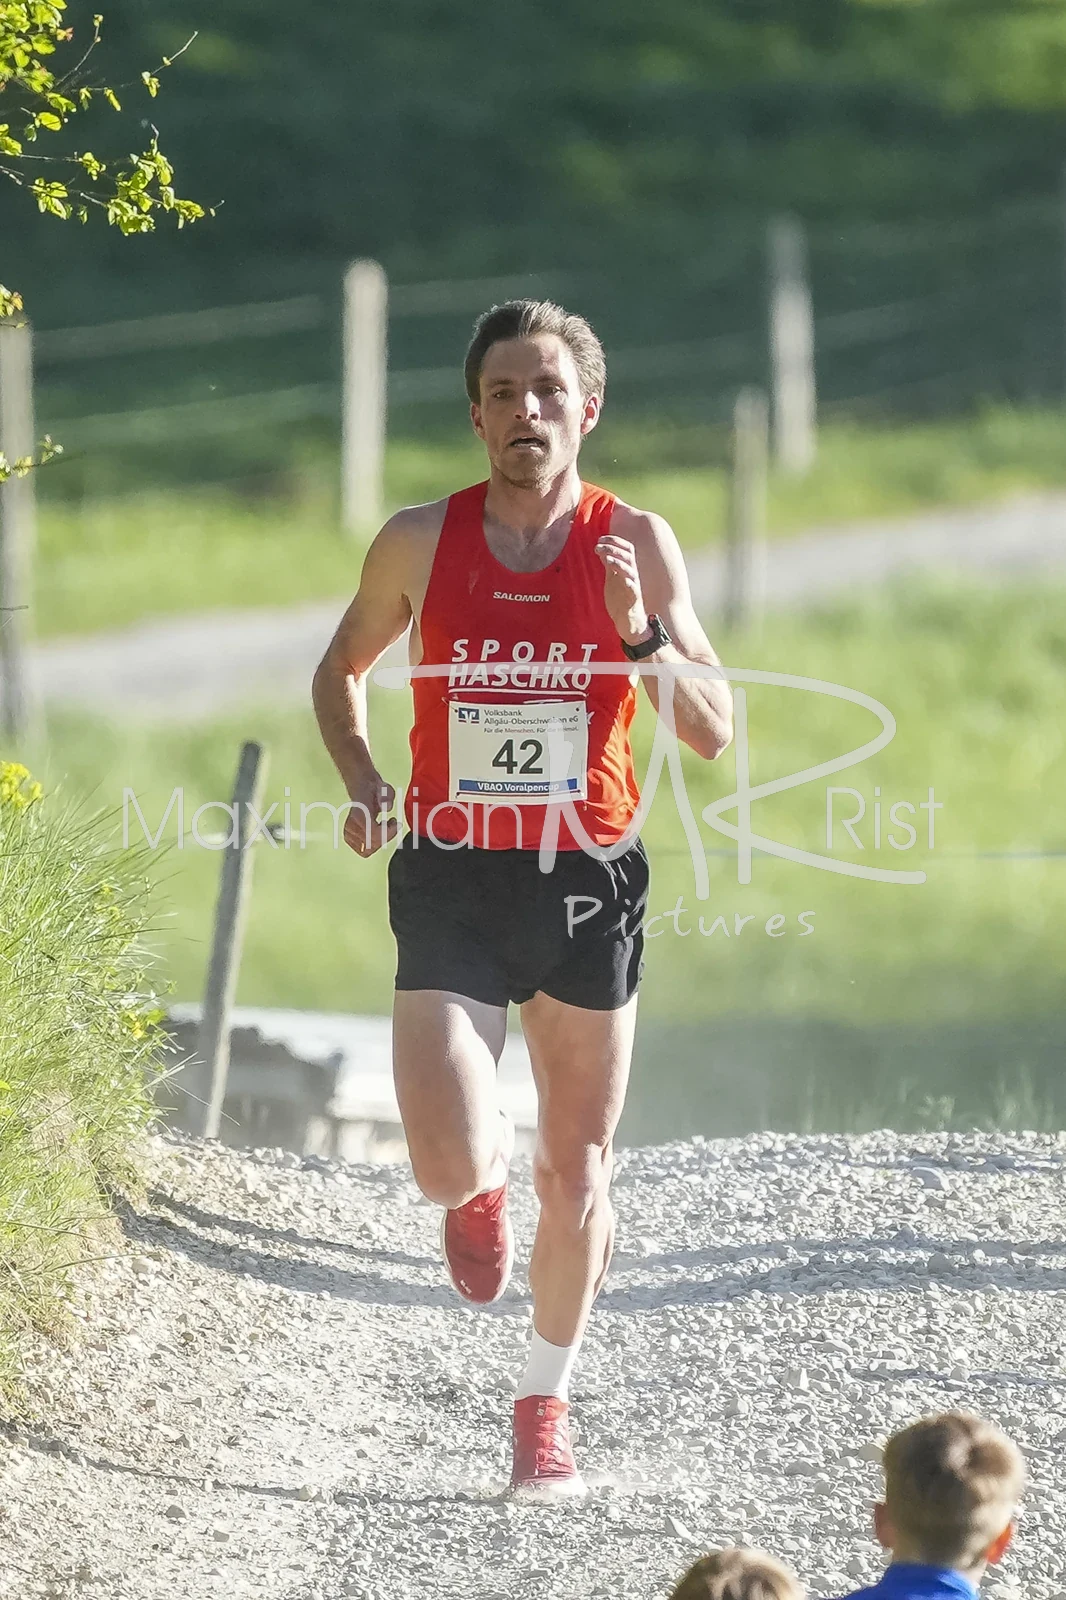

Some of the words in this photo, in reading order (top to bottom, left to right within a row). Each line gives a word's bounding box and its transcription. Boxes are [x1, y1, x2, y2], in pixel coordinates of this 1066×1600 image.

[493, 591, 550, 602] SALOMON
[452, 639, 598, 666] SPORT
[448, 663, 592, 690] HASCHKO
[492, 739, 543, 775] 42
[477, 782, 503, 791] VBAO
[504, 782, 559, 792] Voralpencup
